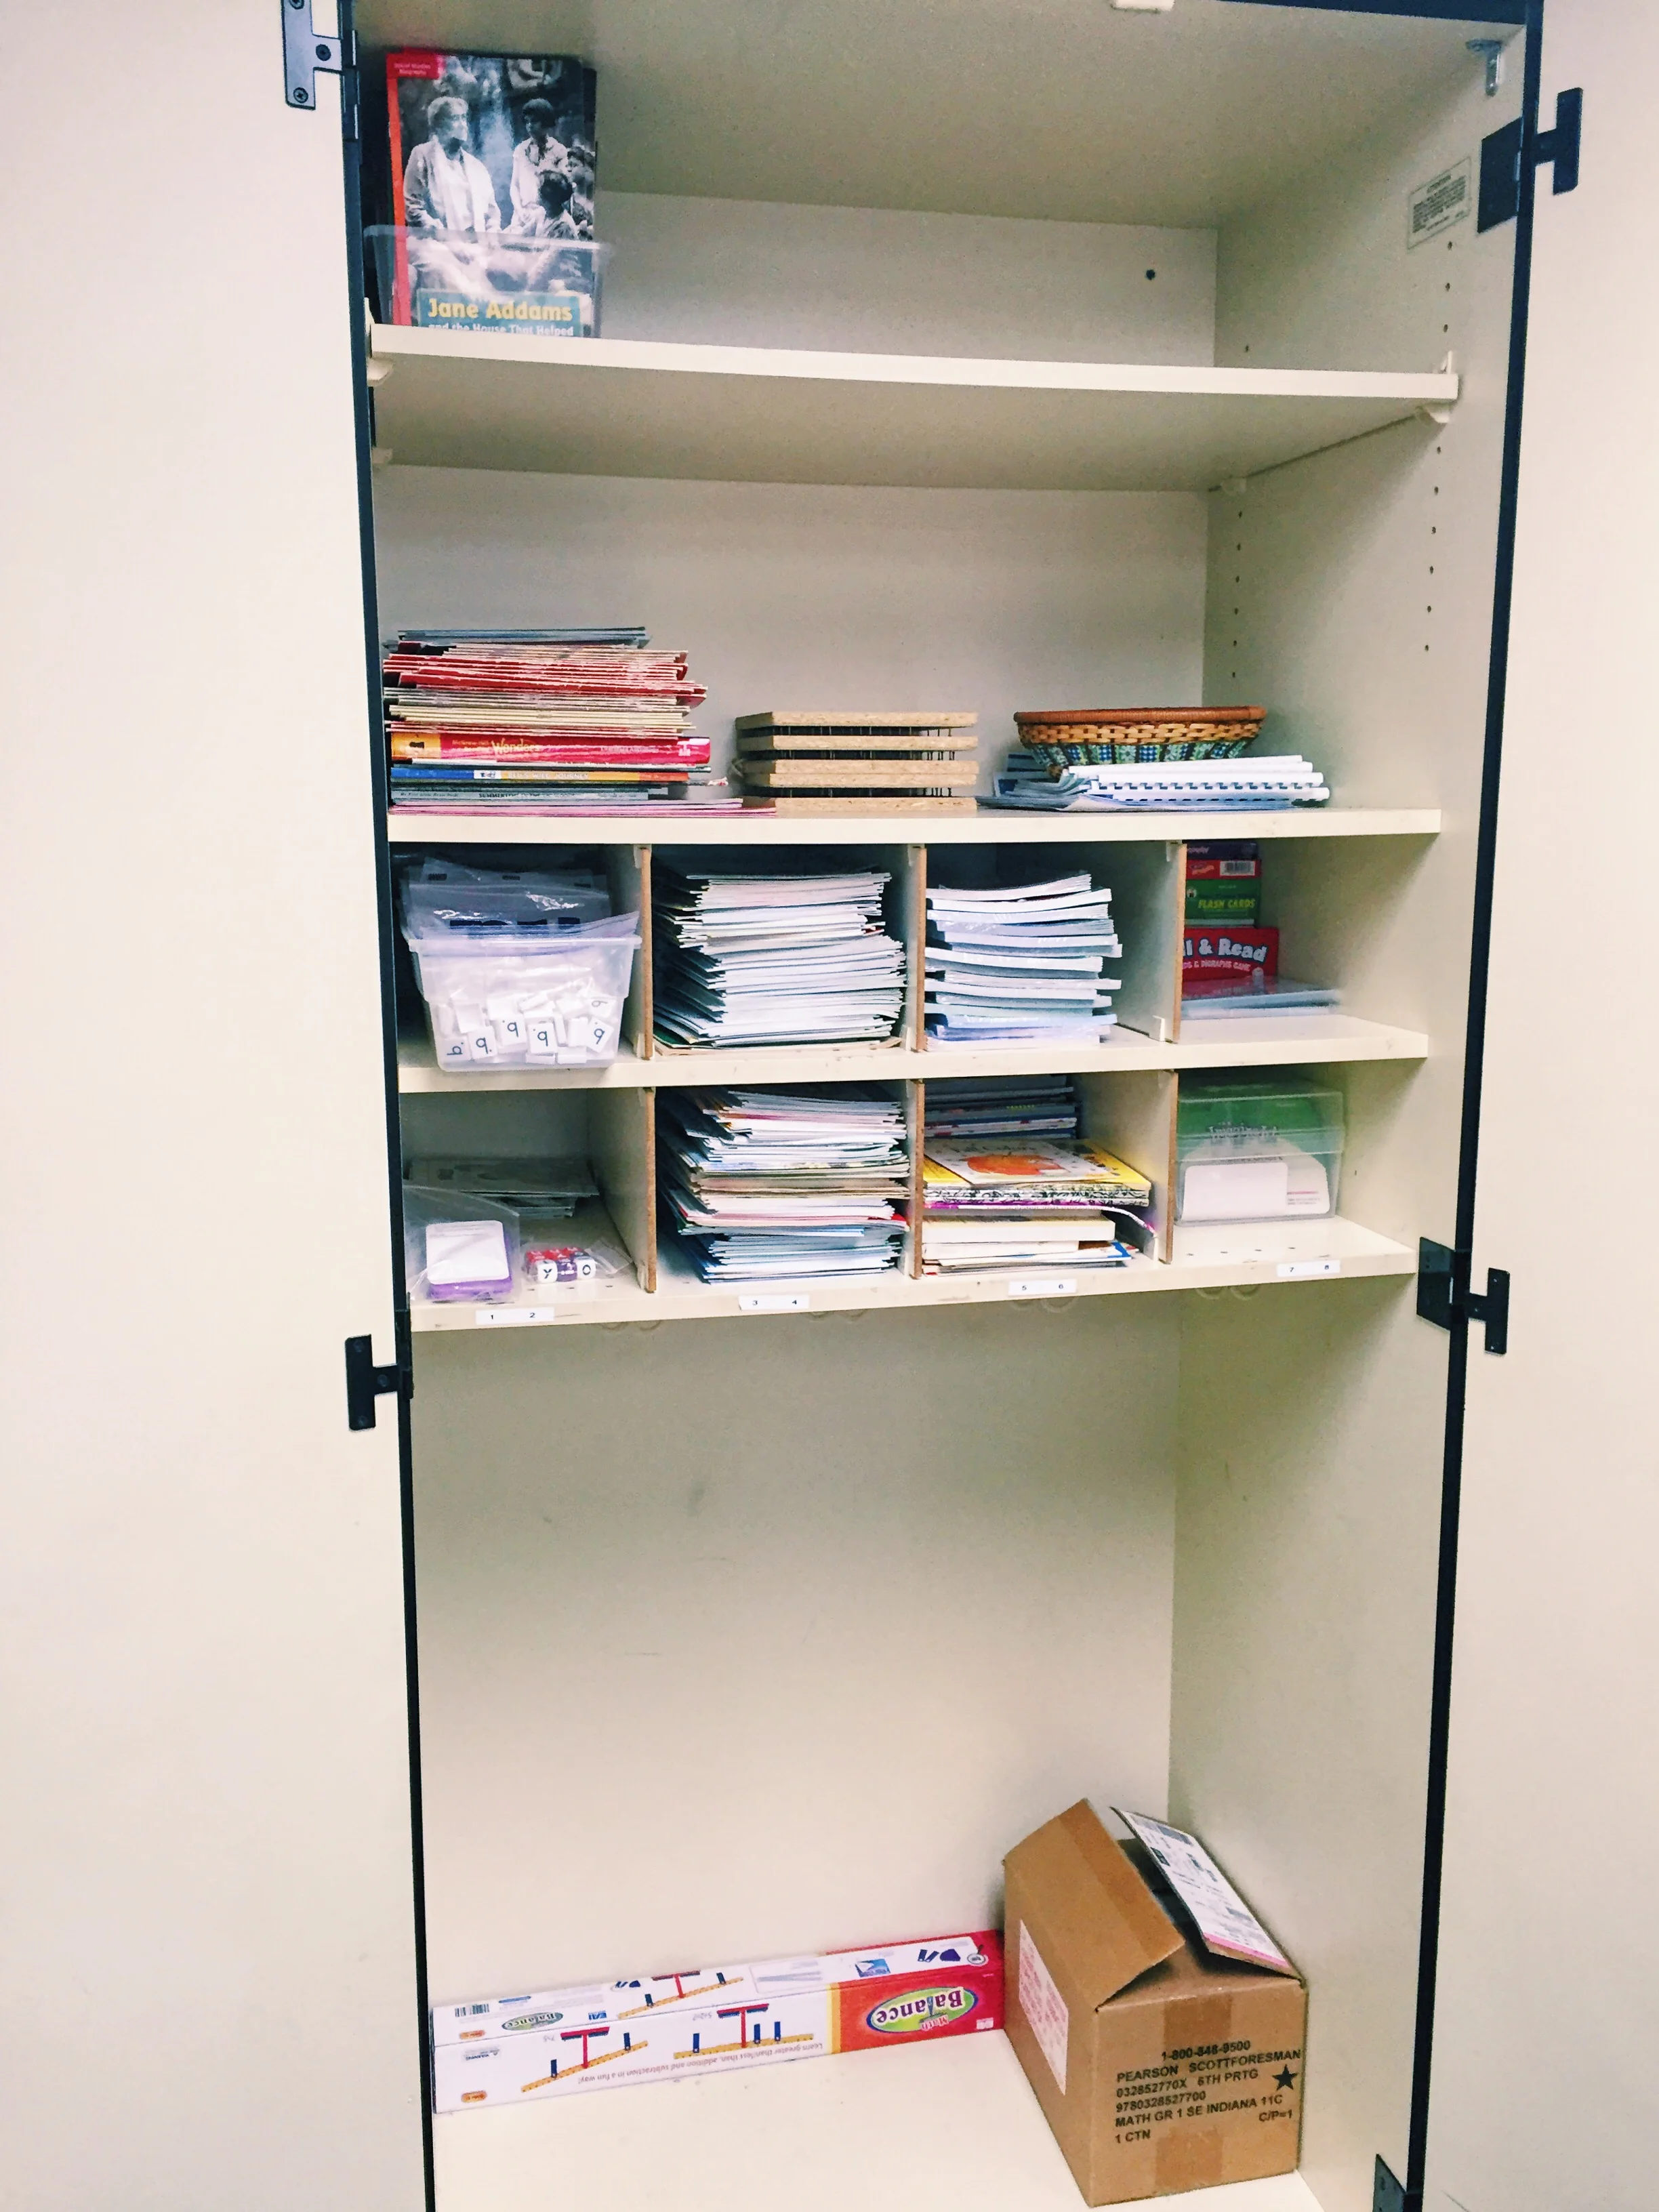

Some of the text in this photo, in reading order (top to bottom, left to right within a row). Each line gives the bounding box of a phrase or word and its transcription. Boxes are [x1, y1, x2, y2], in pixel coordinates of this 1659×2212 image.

[428, 298, 573, 321] Jane Addams
[473, 323, 506, 333] House
[510, 324, 533, 335] That
[536, 325, 574, 337] Helped
[1198, 898, 1255, 909] FLASH CARDS
[1199, 939, 1213, 955] &
[1218, 938, 1267, 962] Read
[1233, 962, 1251, 972] GAME
[544, 1268, 552, 1279] Y
[876, 1989, 963, 2024] Balance
[507, 2012, 556, 2027] Balance
[775, 2045, 802, 2055] greater
[802, 2042, 823, 2051] Learn
[1162, 2040, 1250, 2062] 1-800-848-9500
[671, 2062, 684, 2071] and
[687, 2057, 718, 2068] addition
[1117, 2049, 1300, 2083] PEARSON SCOTTFORESMAN
[597, 2072, 610, 2081] fun
[626, 2065, 669, 2077] subtraction
[1116, 2078, 1187, 2098] 032852770X
[1225, 2068, 1258, 2083] PRTG
[1116, 2090, 1206, 2112] 9780328527700
[1115, 2094, 1283, 2127] MATH GR 1 SE INDIANA 11C
[1258, 2109, 1292, 2122] C/P=1
[1115, 2129, 1151, 2144] 1 CTN
